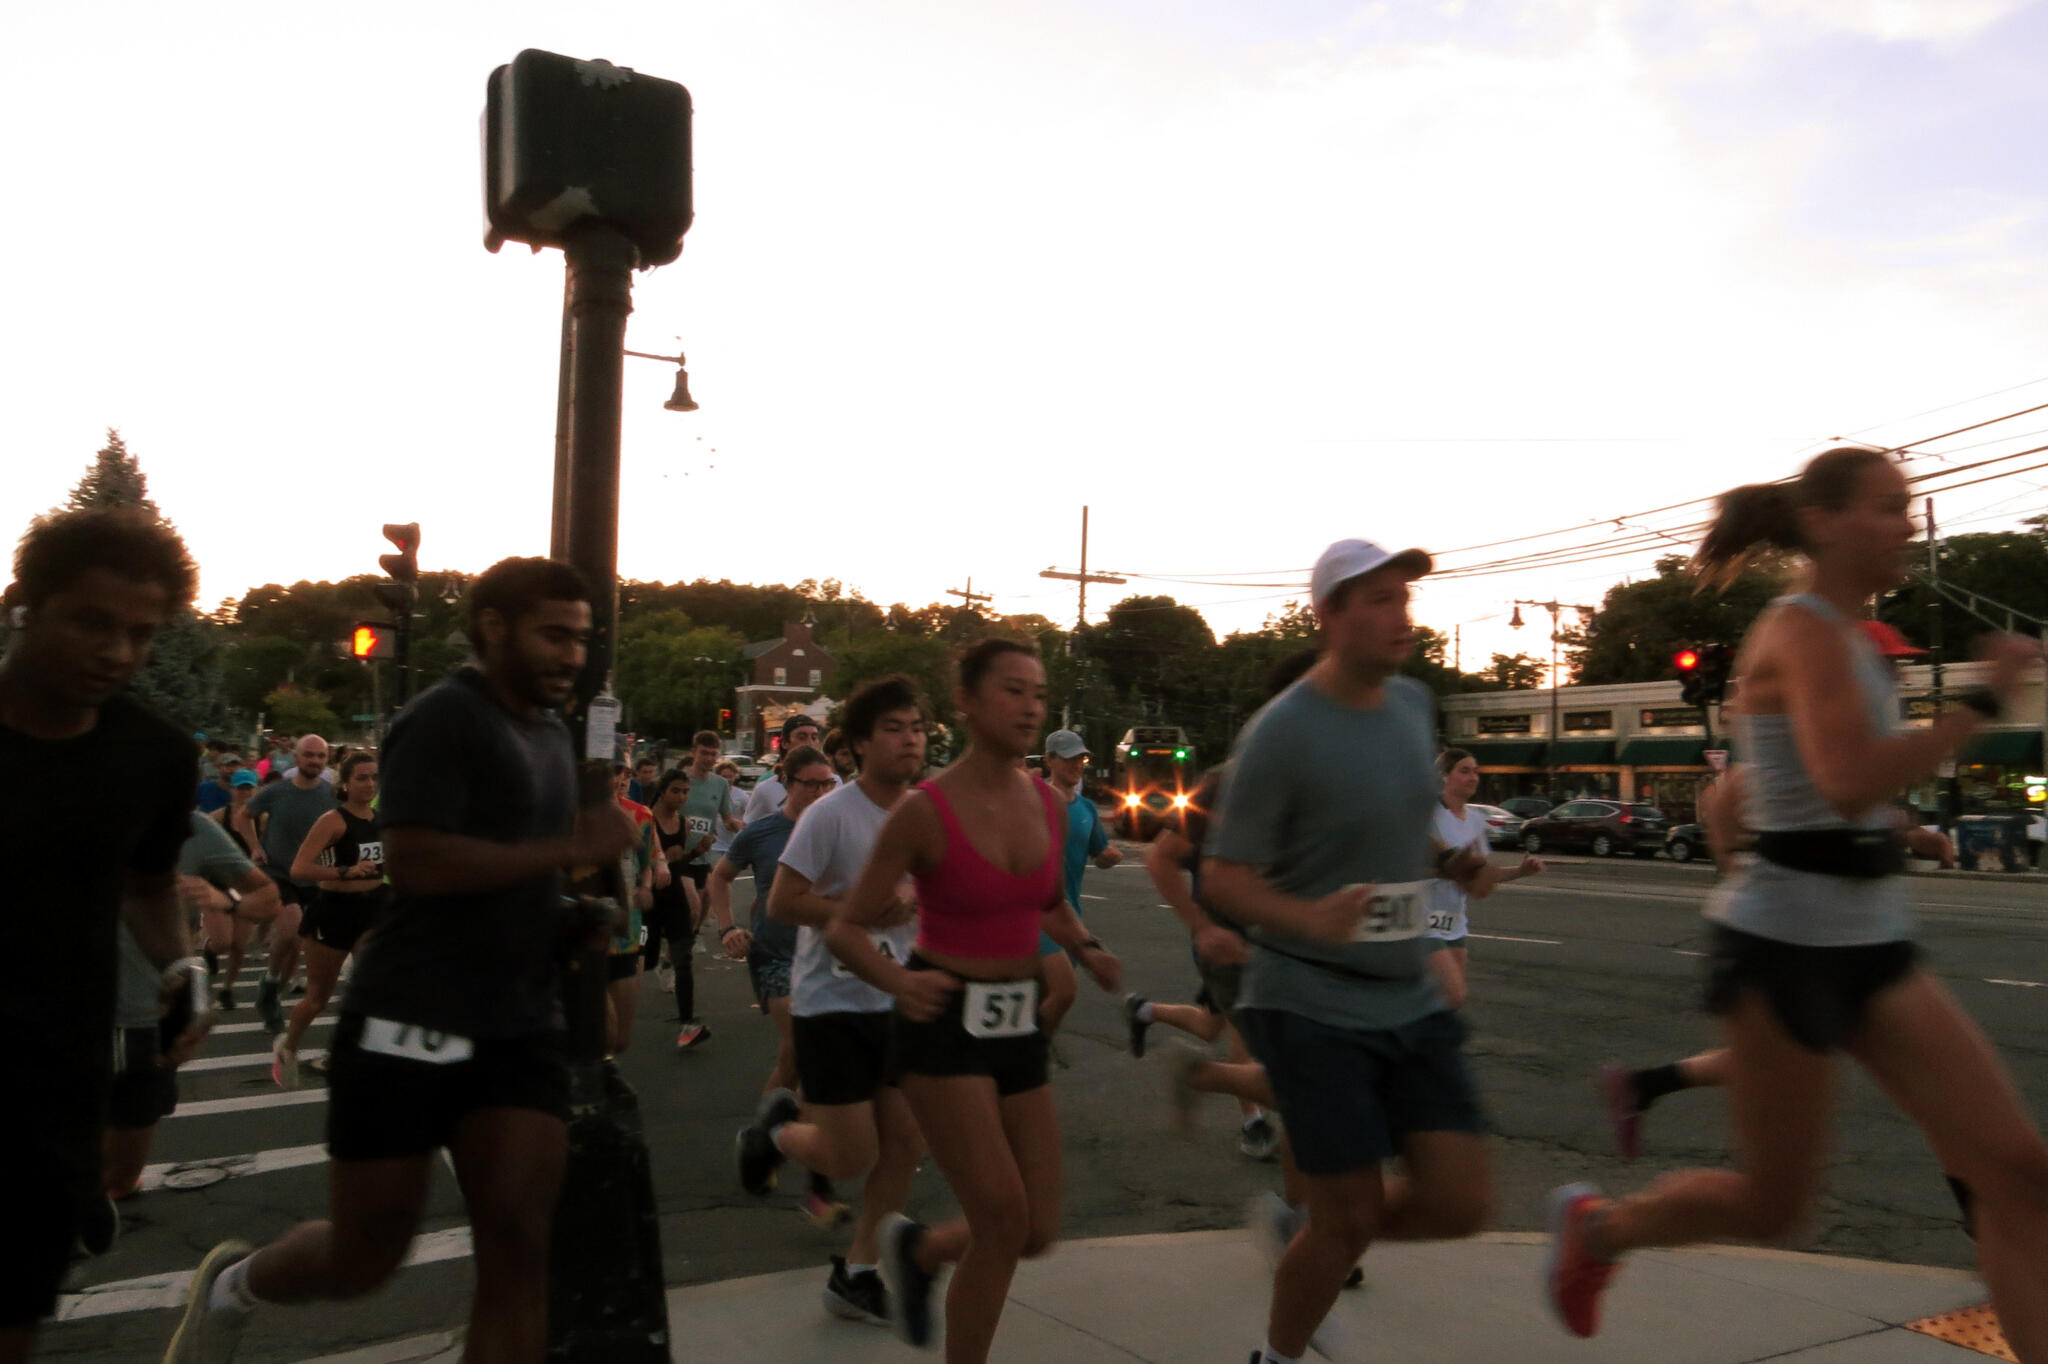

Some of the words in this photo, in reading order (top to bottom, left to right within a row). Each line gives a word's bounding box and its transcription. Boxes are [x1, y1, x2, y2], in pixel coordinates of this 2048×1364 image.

[689, 819, 709, 832] 261
[1430, 915, 1454, 931] 211
[981, 991, 1025, 1029] 57
